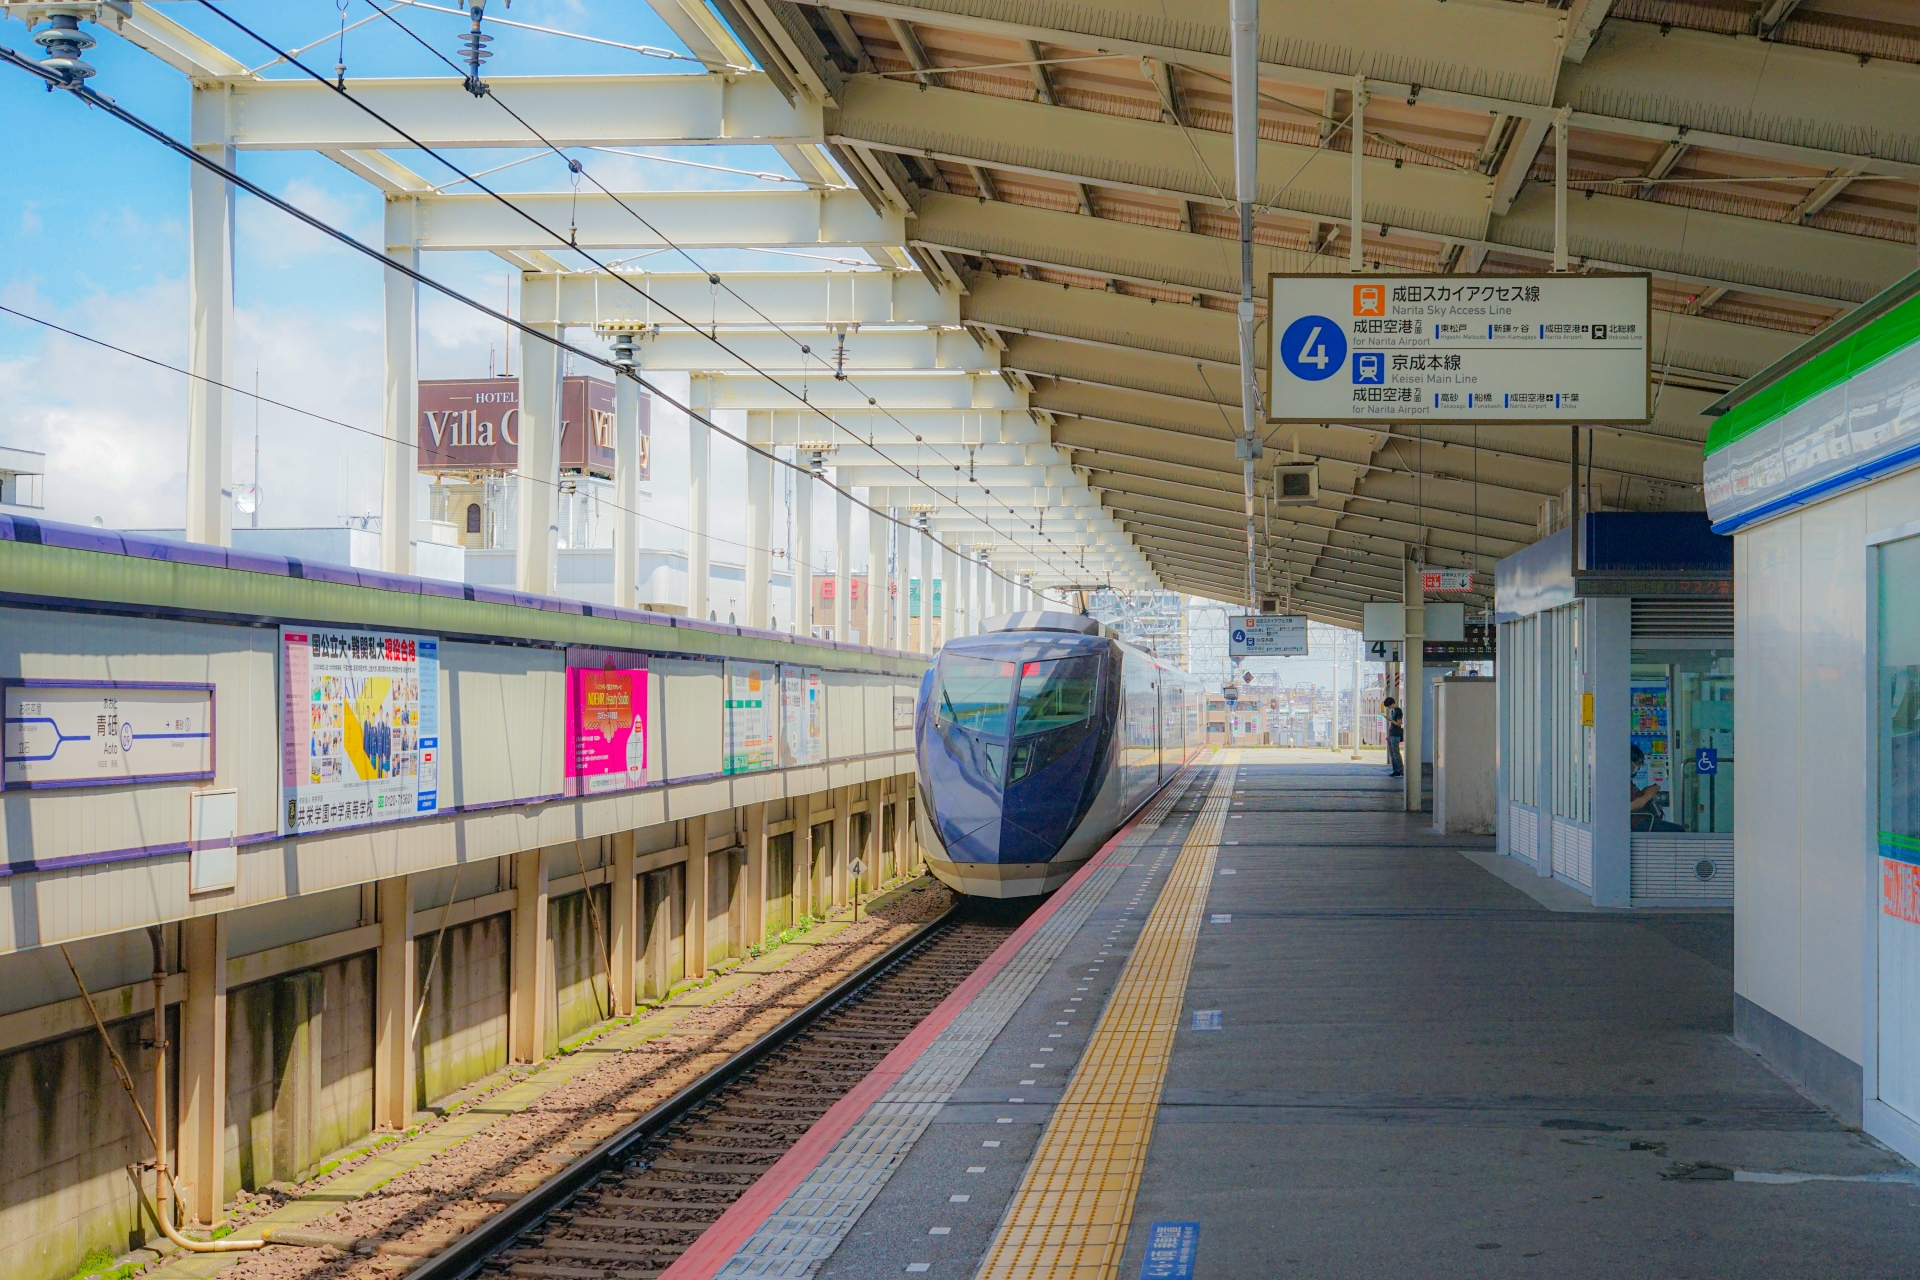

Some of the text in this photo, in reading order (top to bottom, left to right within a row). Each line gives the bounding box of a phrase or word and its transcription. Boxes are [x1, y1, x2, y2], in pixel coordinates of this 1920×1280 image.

[1392, 285, 1540, 303] 成田スカイアクセス線
[1392, 305, 1512, 317] Narita Sky Access Line
[1440, 324, 1467, 333] 東松戸
[1545, 324, 1580, 333] 成田空港
[1609, 324, 1636, 333] 北総線
[1353, 337, 1430, 347] for Narita Airport
[1298, 326, 1329, 370] 4
[1392, 354, 1461, 371] 京成本線
[1392, 374, 1478, 384] Keisei Main Line
[475, 392, 518, 403] HOTEL
[1440, 393, 1458, 402] 高砂
[1474, 393, 1492, 402] 船橋
[1510, 393, 1545, 402] 成田空港
[1561, 393, 1579, 402] 千葉
[1352, 406, 1429, 415] for Narita Airport
[424, 409, 496, 447] Villa
[1235, 631, 1243, 640] 4
[1371, 641, 1387, 658] 4
[343, 677, 373, 699] KYOEI
[19, 703, 41, 715] お花茶屋
[103, 698, 118, 709] あおと
[96, 714, 118, 737] 青砥
[123, 735, 130, 747] 09
[18, 742, 31, 754] 立石
[103, 742, 118, 755] Aoto
[852, 861, 861, 875] 4
